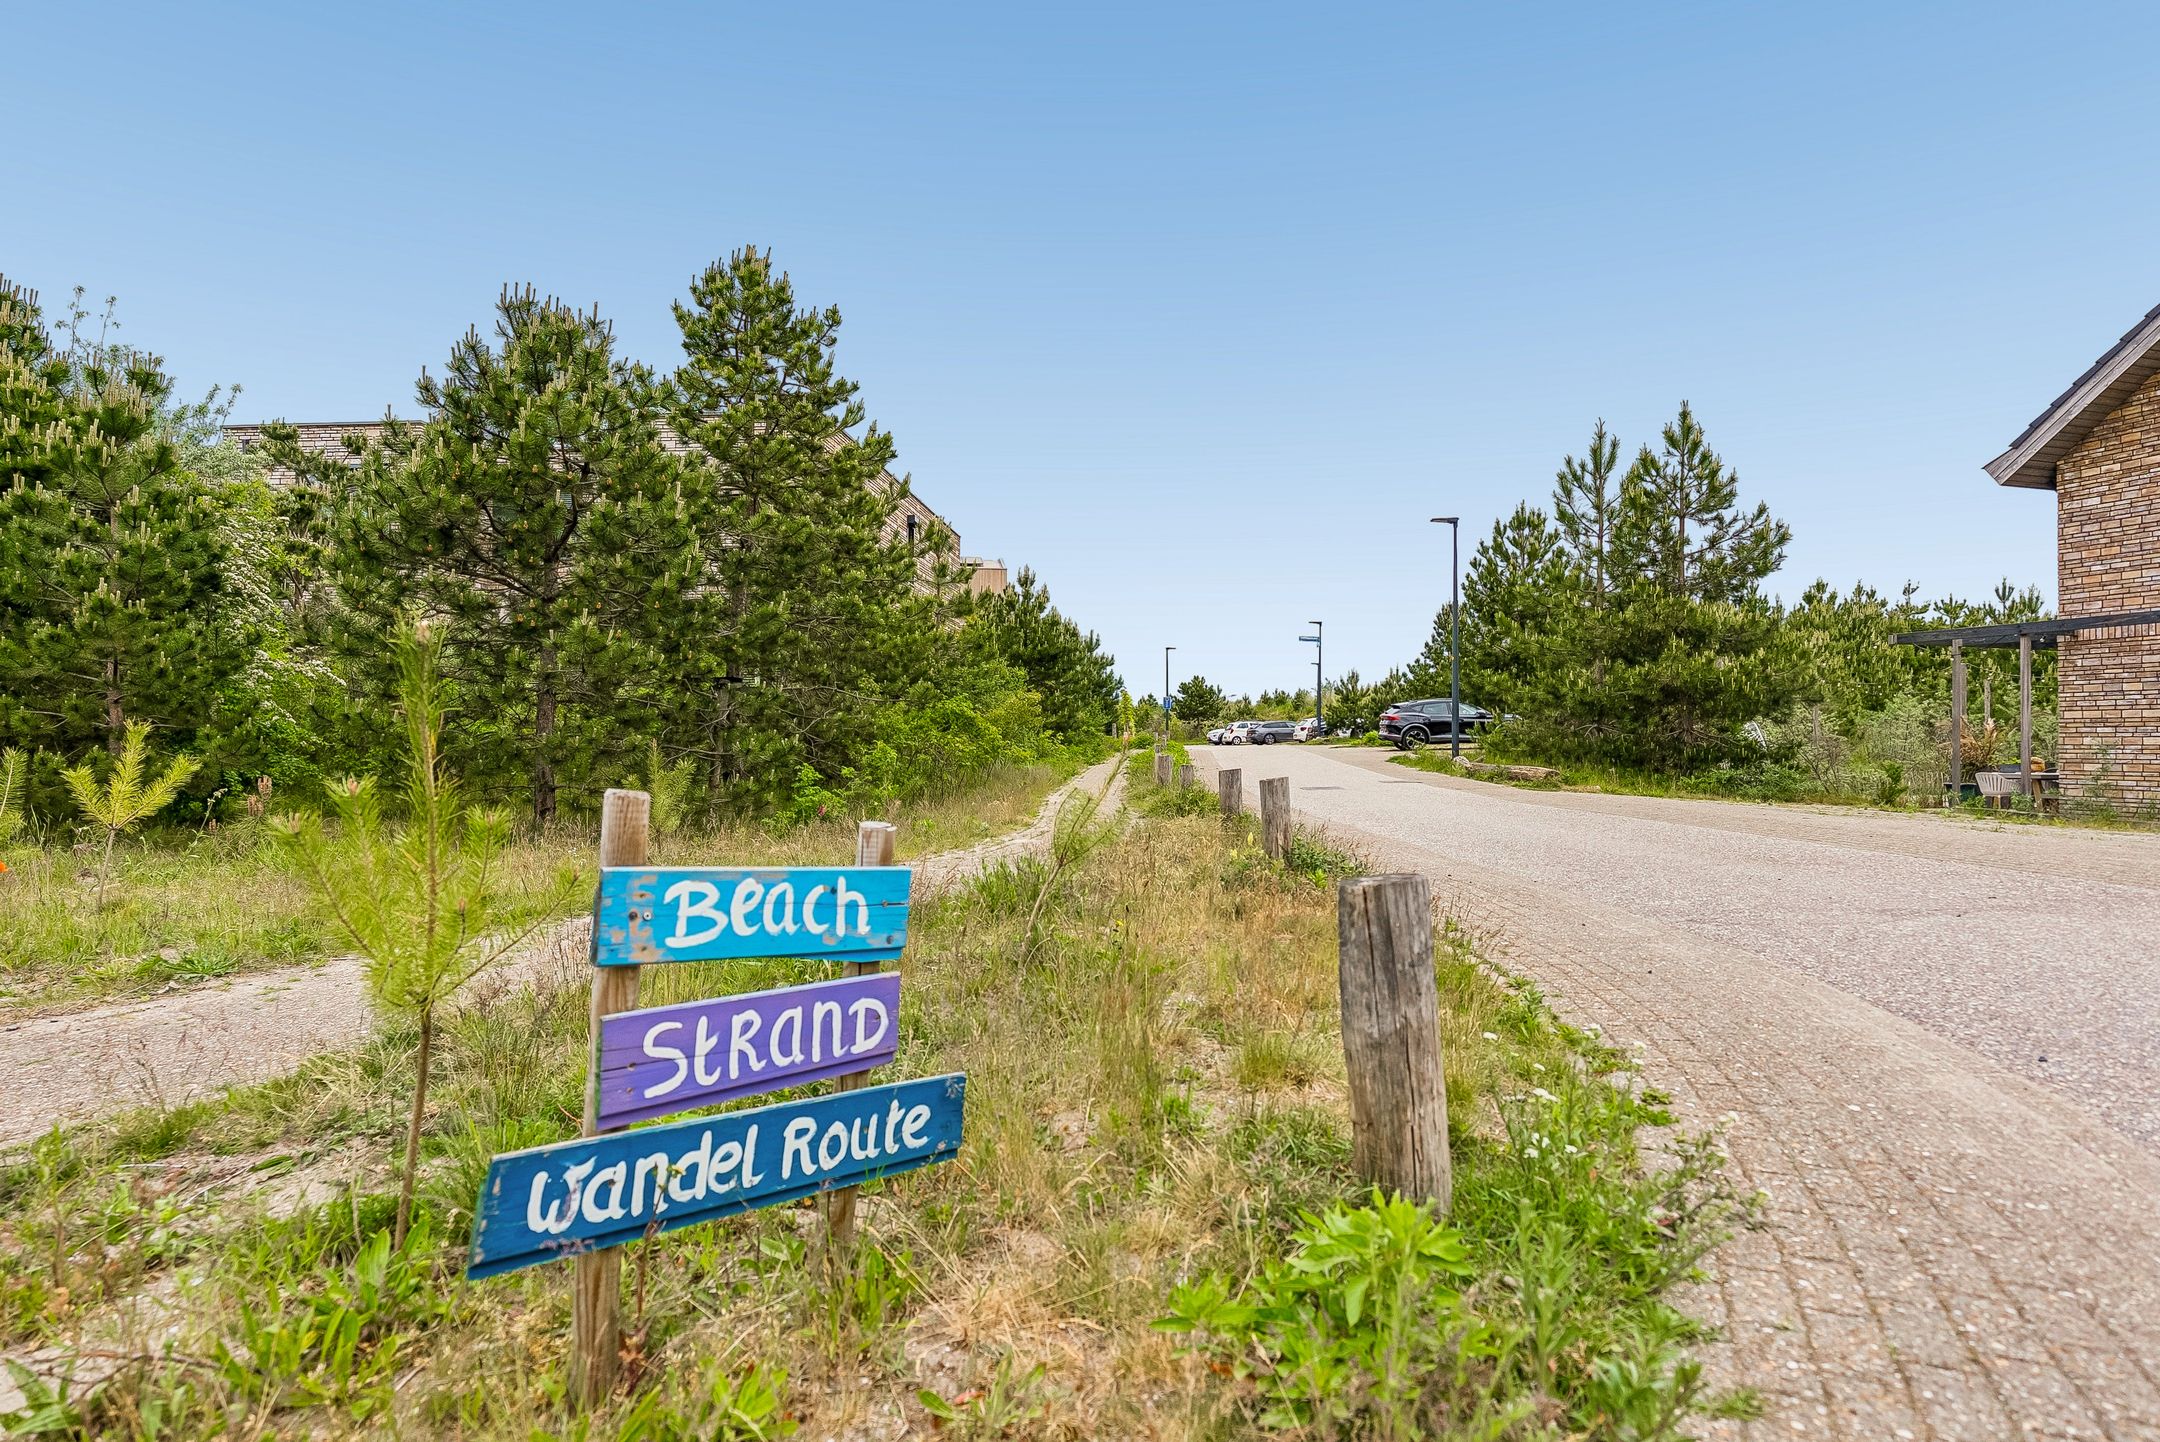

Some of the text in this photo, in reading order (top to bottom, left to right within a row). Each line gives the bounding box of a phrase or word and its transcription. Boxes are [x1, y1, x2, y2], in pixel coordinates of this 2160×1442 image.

[663, 876, 871, 948] Beach
[527, 1099, 932, 1234] Wandel Route
